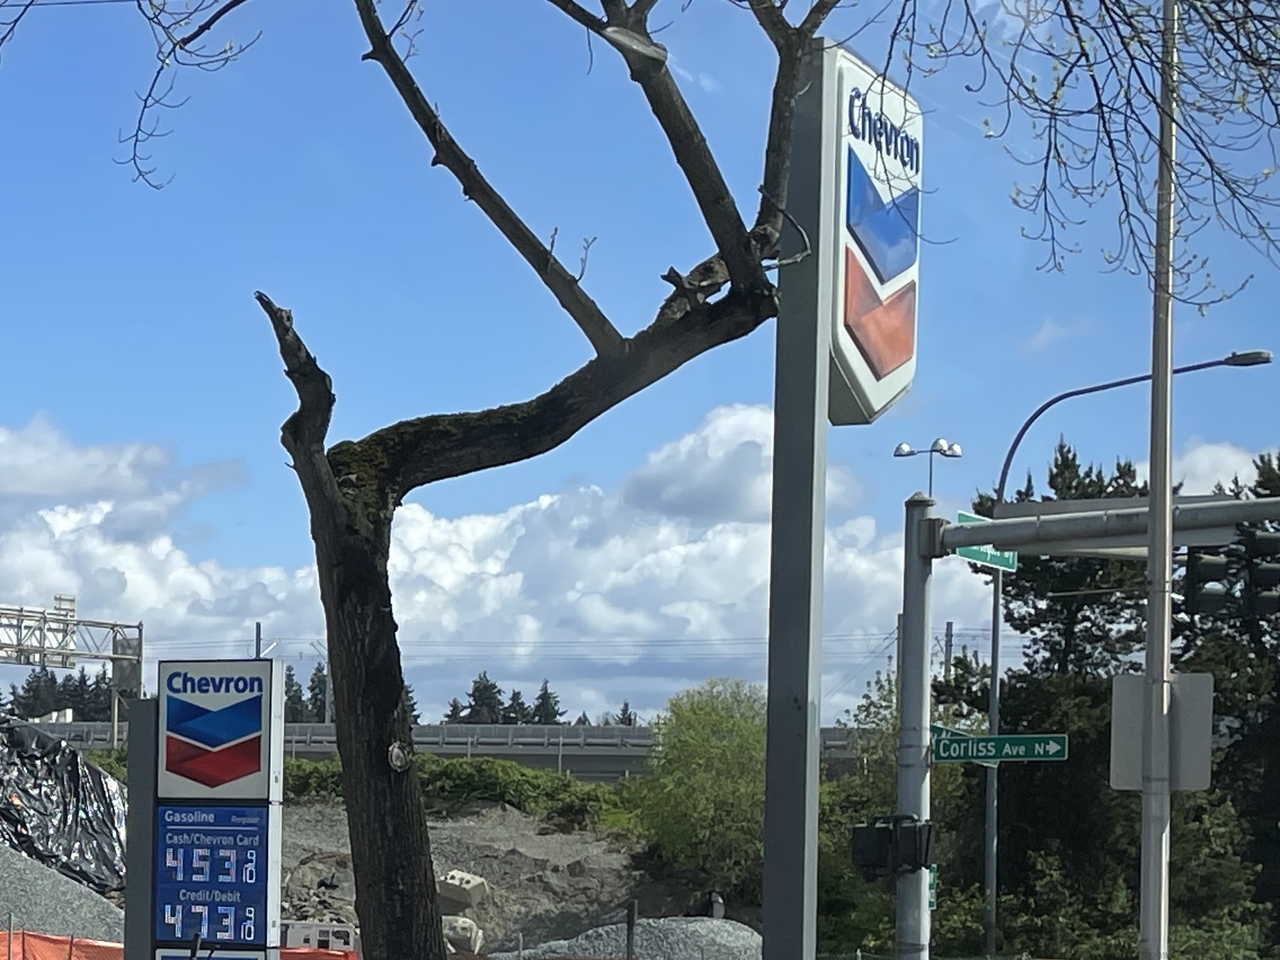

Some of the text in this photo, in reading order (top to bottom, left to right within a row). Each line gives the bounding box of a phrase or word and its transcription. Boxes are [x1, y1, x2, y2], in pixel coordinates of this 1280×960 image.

[848, 86, 919, 175] Chevron
[166, 671, 263, 694] Chevron
[939, 739, 1045, 757] Corliss Ave N
[165, 810, 215, 823] Gasoline
[165, 833, 260, 846] Cash/Chevron Card
[179, 889, 241, 902] Credit/Debit
